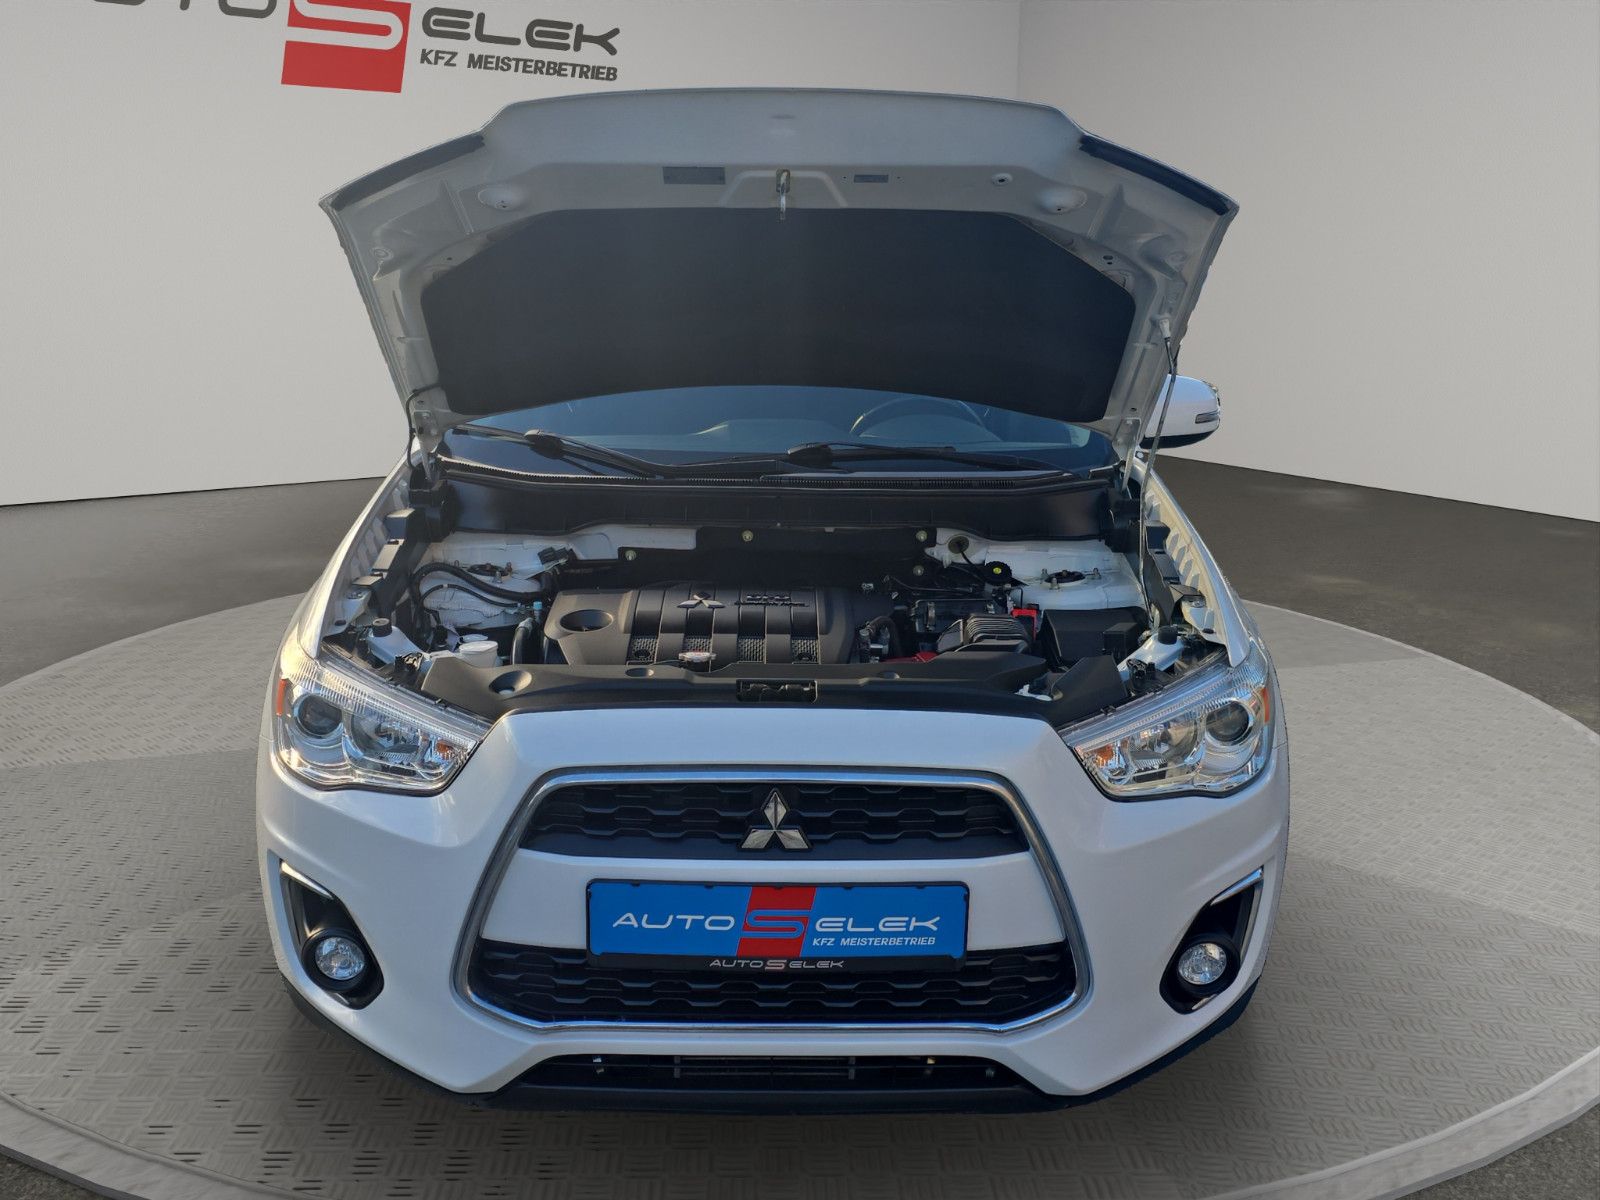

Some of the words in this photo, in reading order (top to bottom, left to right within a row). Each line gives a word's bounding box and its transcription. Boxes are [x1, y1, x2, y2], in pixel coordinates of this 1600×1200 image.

[419, 49, 458, 67] KFZ
[467, 53, 618, 82] MEISTERBETRIEB
[812, 937, 835, 946] KFZ
[840, 936, 936, 946] MEISTERBETRIEB
